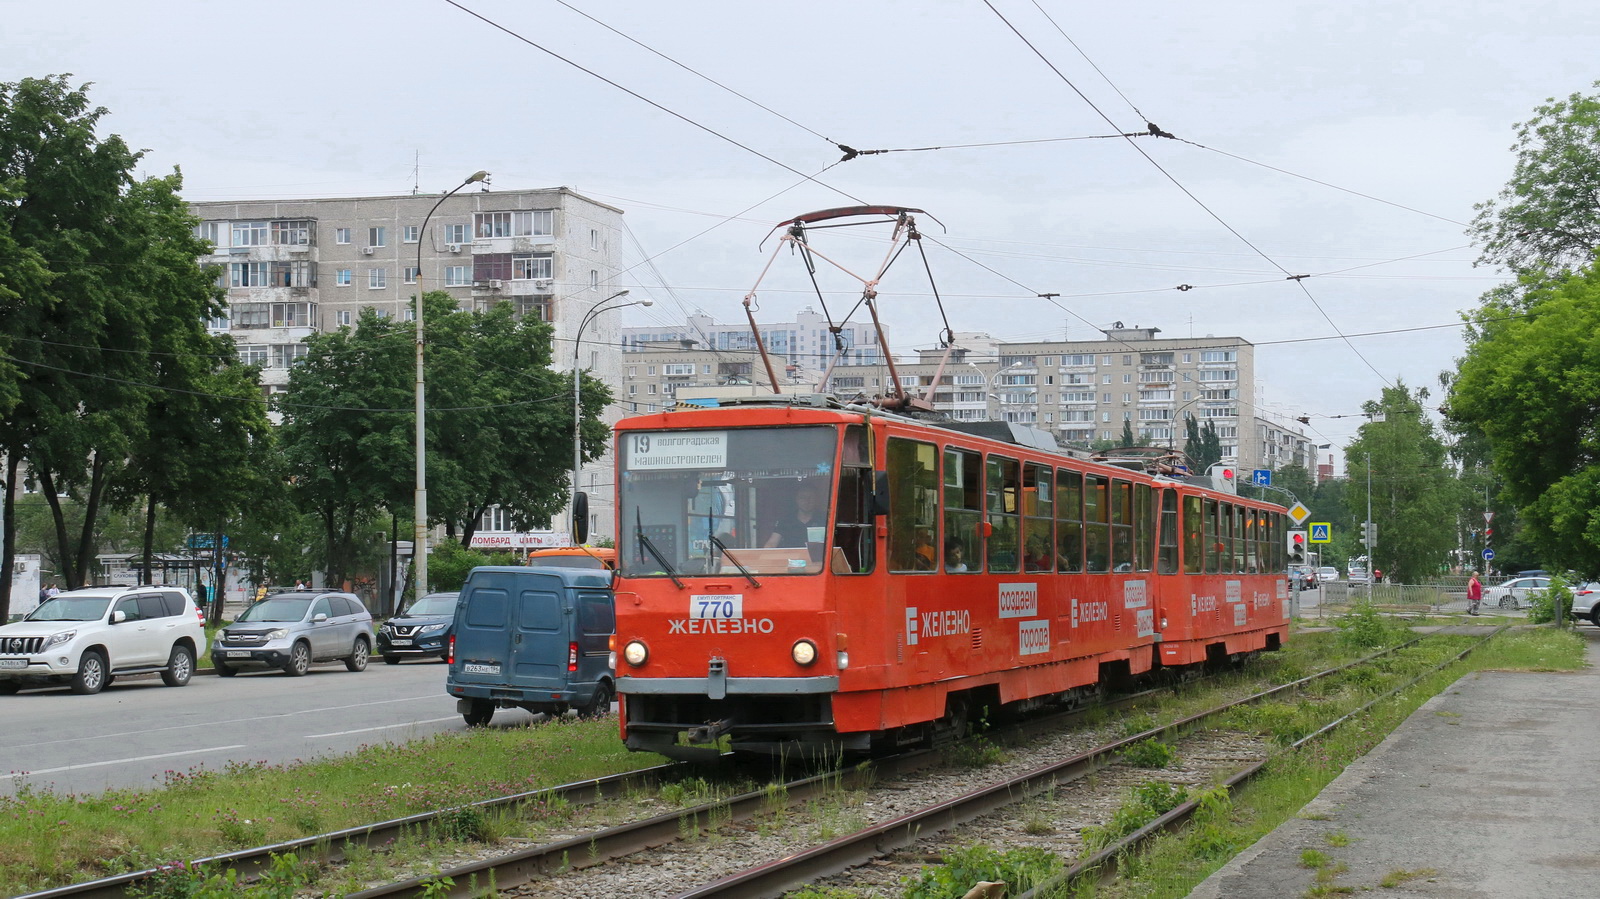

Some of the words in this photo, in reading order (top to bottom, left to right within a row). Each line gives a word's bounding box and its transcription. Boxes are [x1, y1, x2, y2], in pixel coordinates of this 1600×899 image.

[633, 435, 650, 454] 19
[471, 536, 511, 545] ЛОМБАРД
[698, 600, 734, 618] 770
[1000, 590, 1036, 614] создаем
[1079, 601, 1108, 623] ЖЕЛЕЗНО
[667, 618, 774, 634] ЖЕЛЕЗНО
[921, 609, 970, 638] ЖЕЛЕЗНО
[1020, 627, 1048, 655] города
